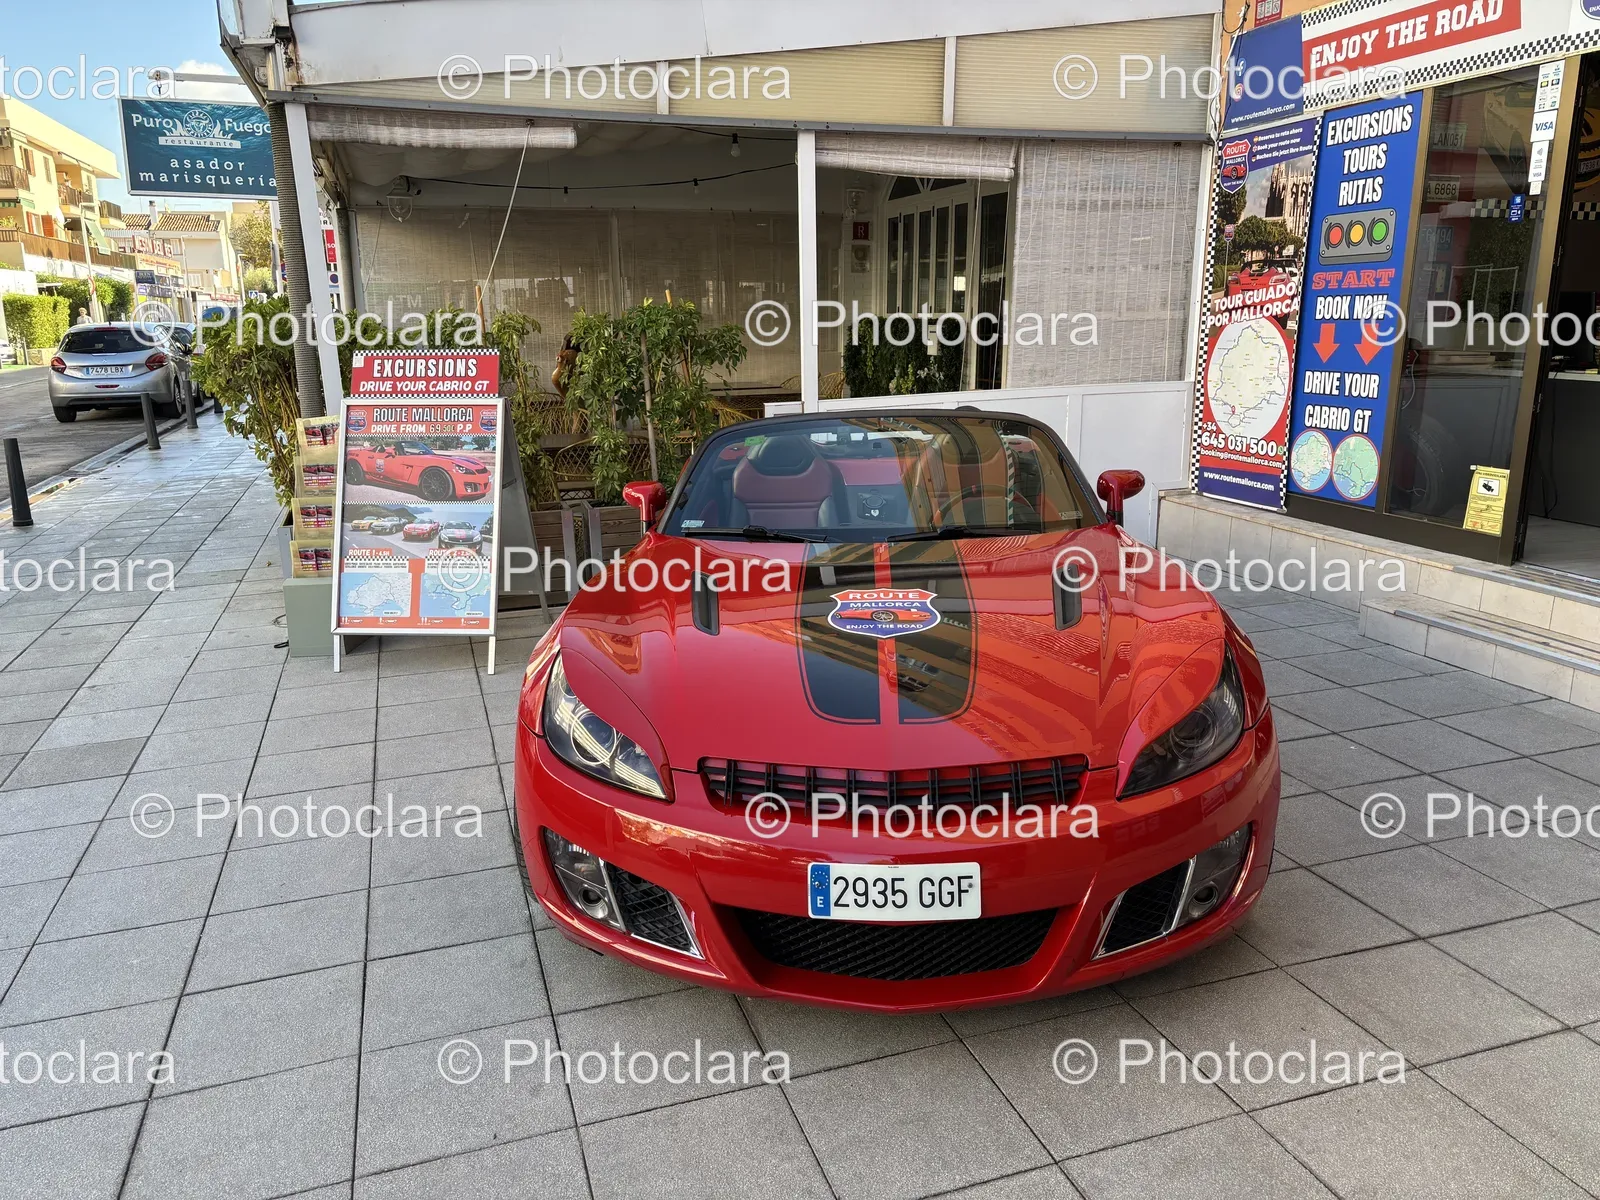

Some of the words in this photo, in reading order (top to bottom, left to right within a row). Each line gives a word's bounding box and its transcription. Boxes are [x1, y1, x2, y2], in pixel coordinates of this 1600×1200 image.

[1310, 29, 1379, 69] ENJOY
[1386, 14, 1429, 49] THE
[1435, 0, 1505, 37] ROAD
[131, 113, 173, 128] Puro
[1231, 103, 1295, 123] www.routemallorca.com
[1326, 104, 1413, 146] EXCURSIONS
[1535, 121, 1554, 132] VISA
[165, 138, 234, 147] restaurante
[1226, 145, 1246, 155] ROUTE
[170, 158, 245, 171] asador
[1343, 143, 1388, 175] TOURS
[139, 171, 277, 187] marisquería
[1338, 176, 1384, 207] RUTAS
[1434, 183, 1457, 196] 6868
[1312, 268, 1395, 290] START
[1214, 293, 1244, 312] TOUR
[1245, 282, 1297, 305] GUIADO
[1315, 296, 1351, 320] BOOK
[1353, 294, 1388, 320] NOW
[1206, 311, 1230, 329] POR
[1231, 297, 1300, 324] MALLORCA
[373, 358, 478, 378] EXCURSIONS
[359, 381, 393, 392] DRIVE
[396, 381, 427, 392] YOUR
[429, 380, 472, 392] CABRIO
[474, 380, 490, 391] GT
[1304, 370, 1341, 396] DRIVE
[1344, 372, 1380, 399] YOUR
[373, 408, 409, 422] ROUTE
[412, 407, 473, 422] MALLORCA
[1305, 405, 1350, 431] CABRIO
[1354, 409, 1372, 434] GT
[371, 424, 397, 433] DRIVE
[400, 424, 426, 433] FROM
[1202, 421, 1217, 432] +34
[1201, 432, 1226, 449] 645
[1228, 435, 1247, 453] 031
[1249, 439, 1277, 457] 500
[1200, 448, 1283, 469] booking@routemallorca.com
[1203, 471, 1275, 491] www.routemallorca.com
[848, 592, 920, 600] ROUTE
[817, 896, 824, 907] E
[833, 875, 908, 909] 2935
[918, 875, 974, 908] GGF
